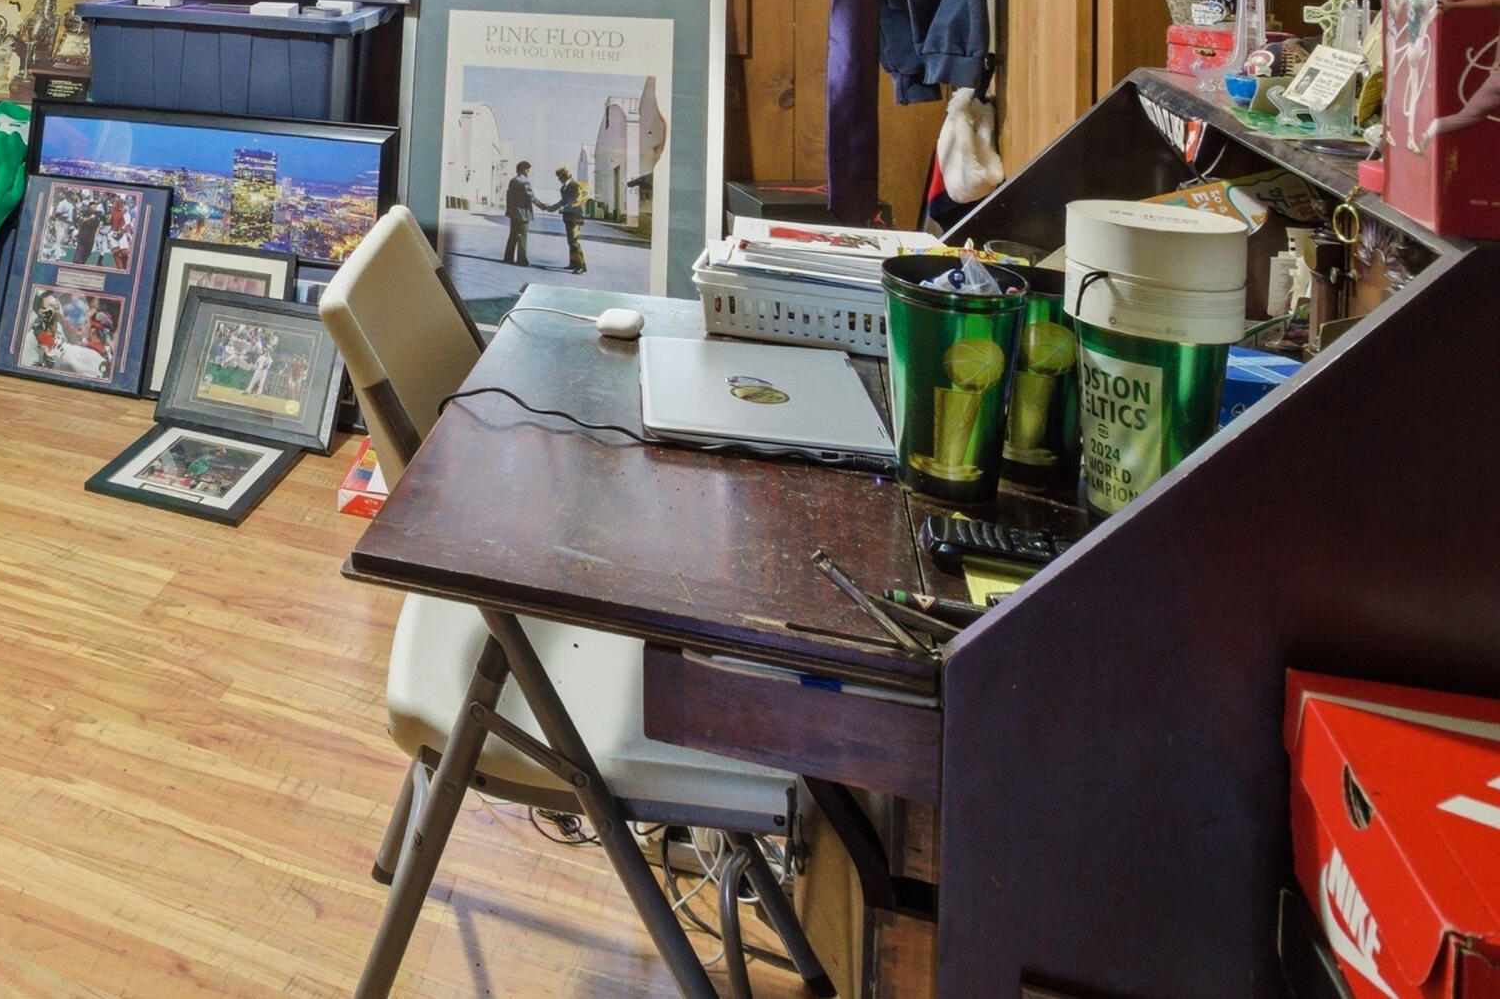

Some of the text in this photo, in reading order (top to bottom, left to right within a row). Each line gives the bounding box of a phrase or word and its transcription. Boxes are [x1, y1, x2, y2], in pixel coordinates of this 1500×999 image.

[485, 25, 625, 49] PINK FLOYD
[485, 44, 622, 61] WISH YOU WERE HERE
[1083, 362, 1151, 405] OSTON
[1082, 389, 1148, 431] ELTICS
[1090, 438, 1121, 462] 2024
[1088, 457, 1132, 484] WORLD
